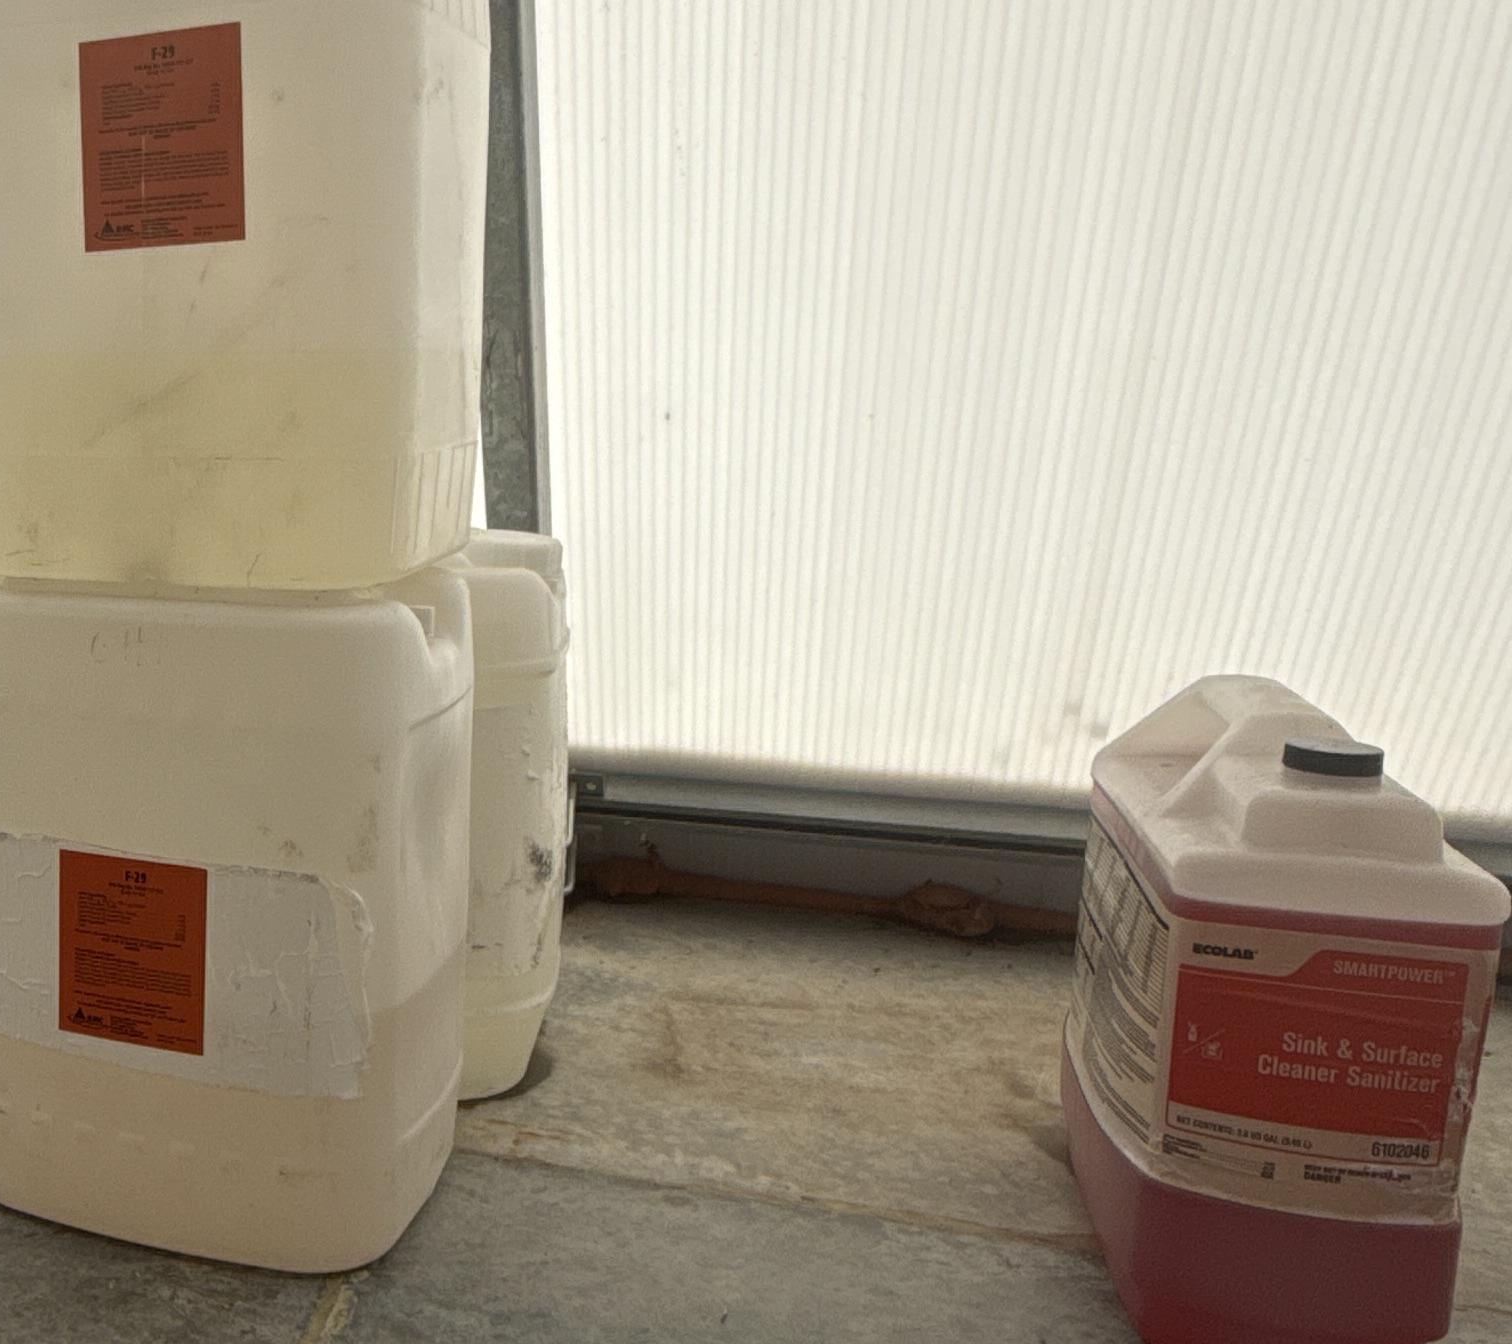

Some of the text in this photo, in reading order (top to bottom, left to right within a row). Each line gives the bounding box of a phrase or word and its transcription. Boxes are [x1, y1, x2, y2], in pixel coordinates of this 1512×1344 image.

[151, 45, 175, 61] F-29
[125, 870, 147, 884] F-29
[1282, 1032, 1444, 1069] Sink & Surface
[1257, 1056, 1441, 1094] Cleaner Sanitizer
[1371, 1141, 1430, 1161] 6102046
